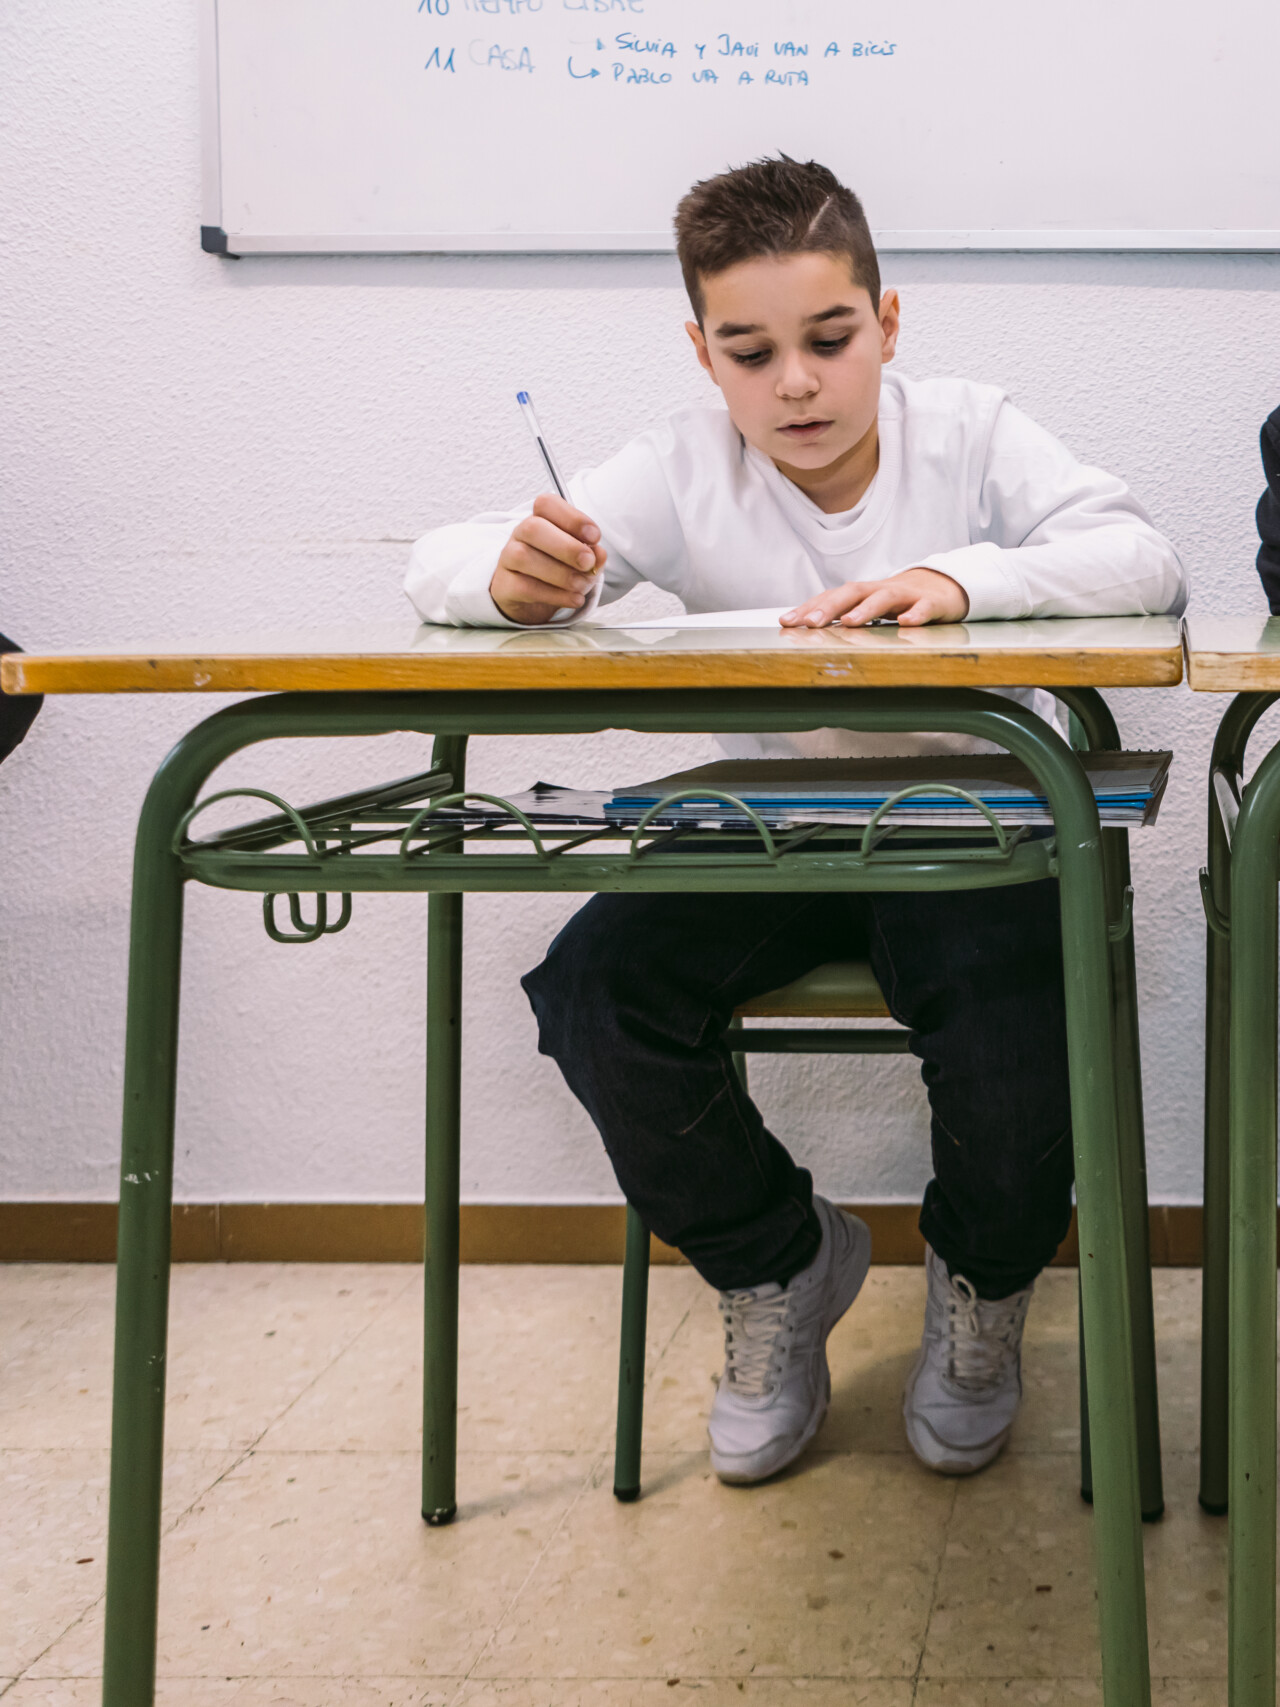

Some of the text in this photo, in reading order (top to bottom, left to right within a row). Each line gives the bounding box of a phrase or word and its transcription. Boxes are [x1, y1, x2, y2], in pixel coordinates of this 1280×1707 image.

[417, 0, 450, 15] 10
[424, 39, 536, 73] 11 CASA
[824, 41, 841, 58] A
[612, 62, 672, 84] PABLO
[738, 71, 754, 85] A
[764, 69, 808, 86] RUTA
